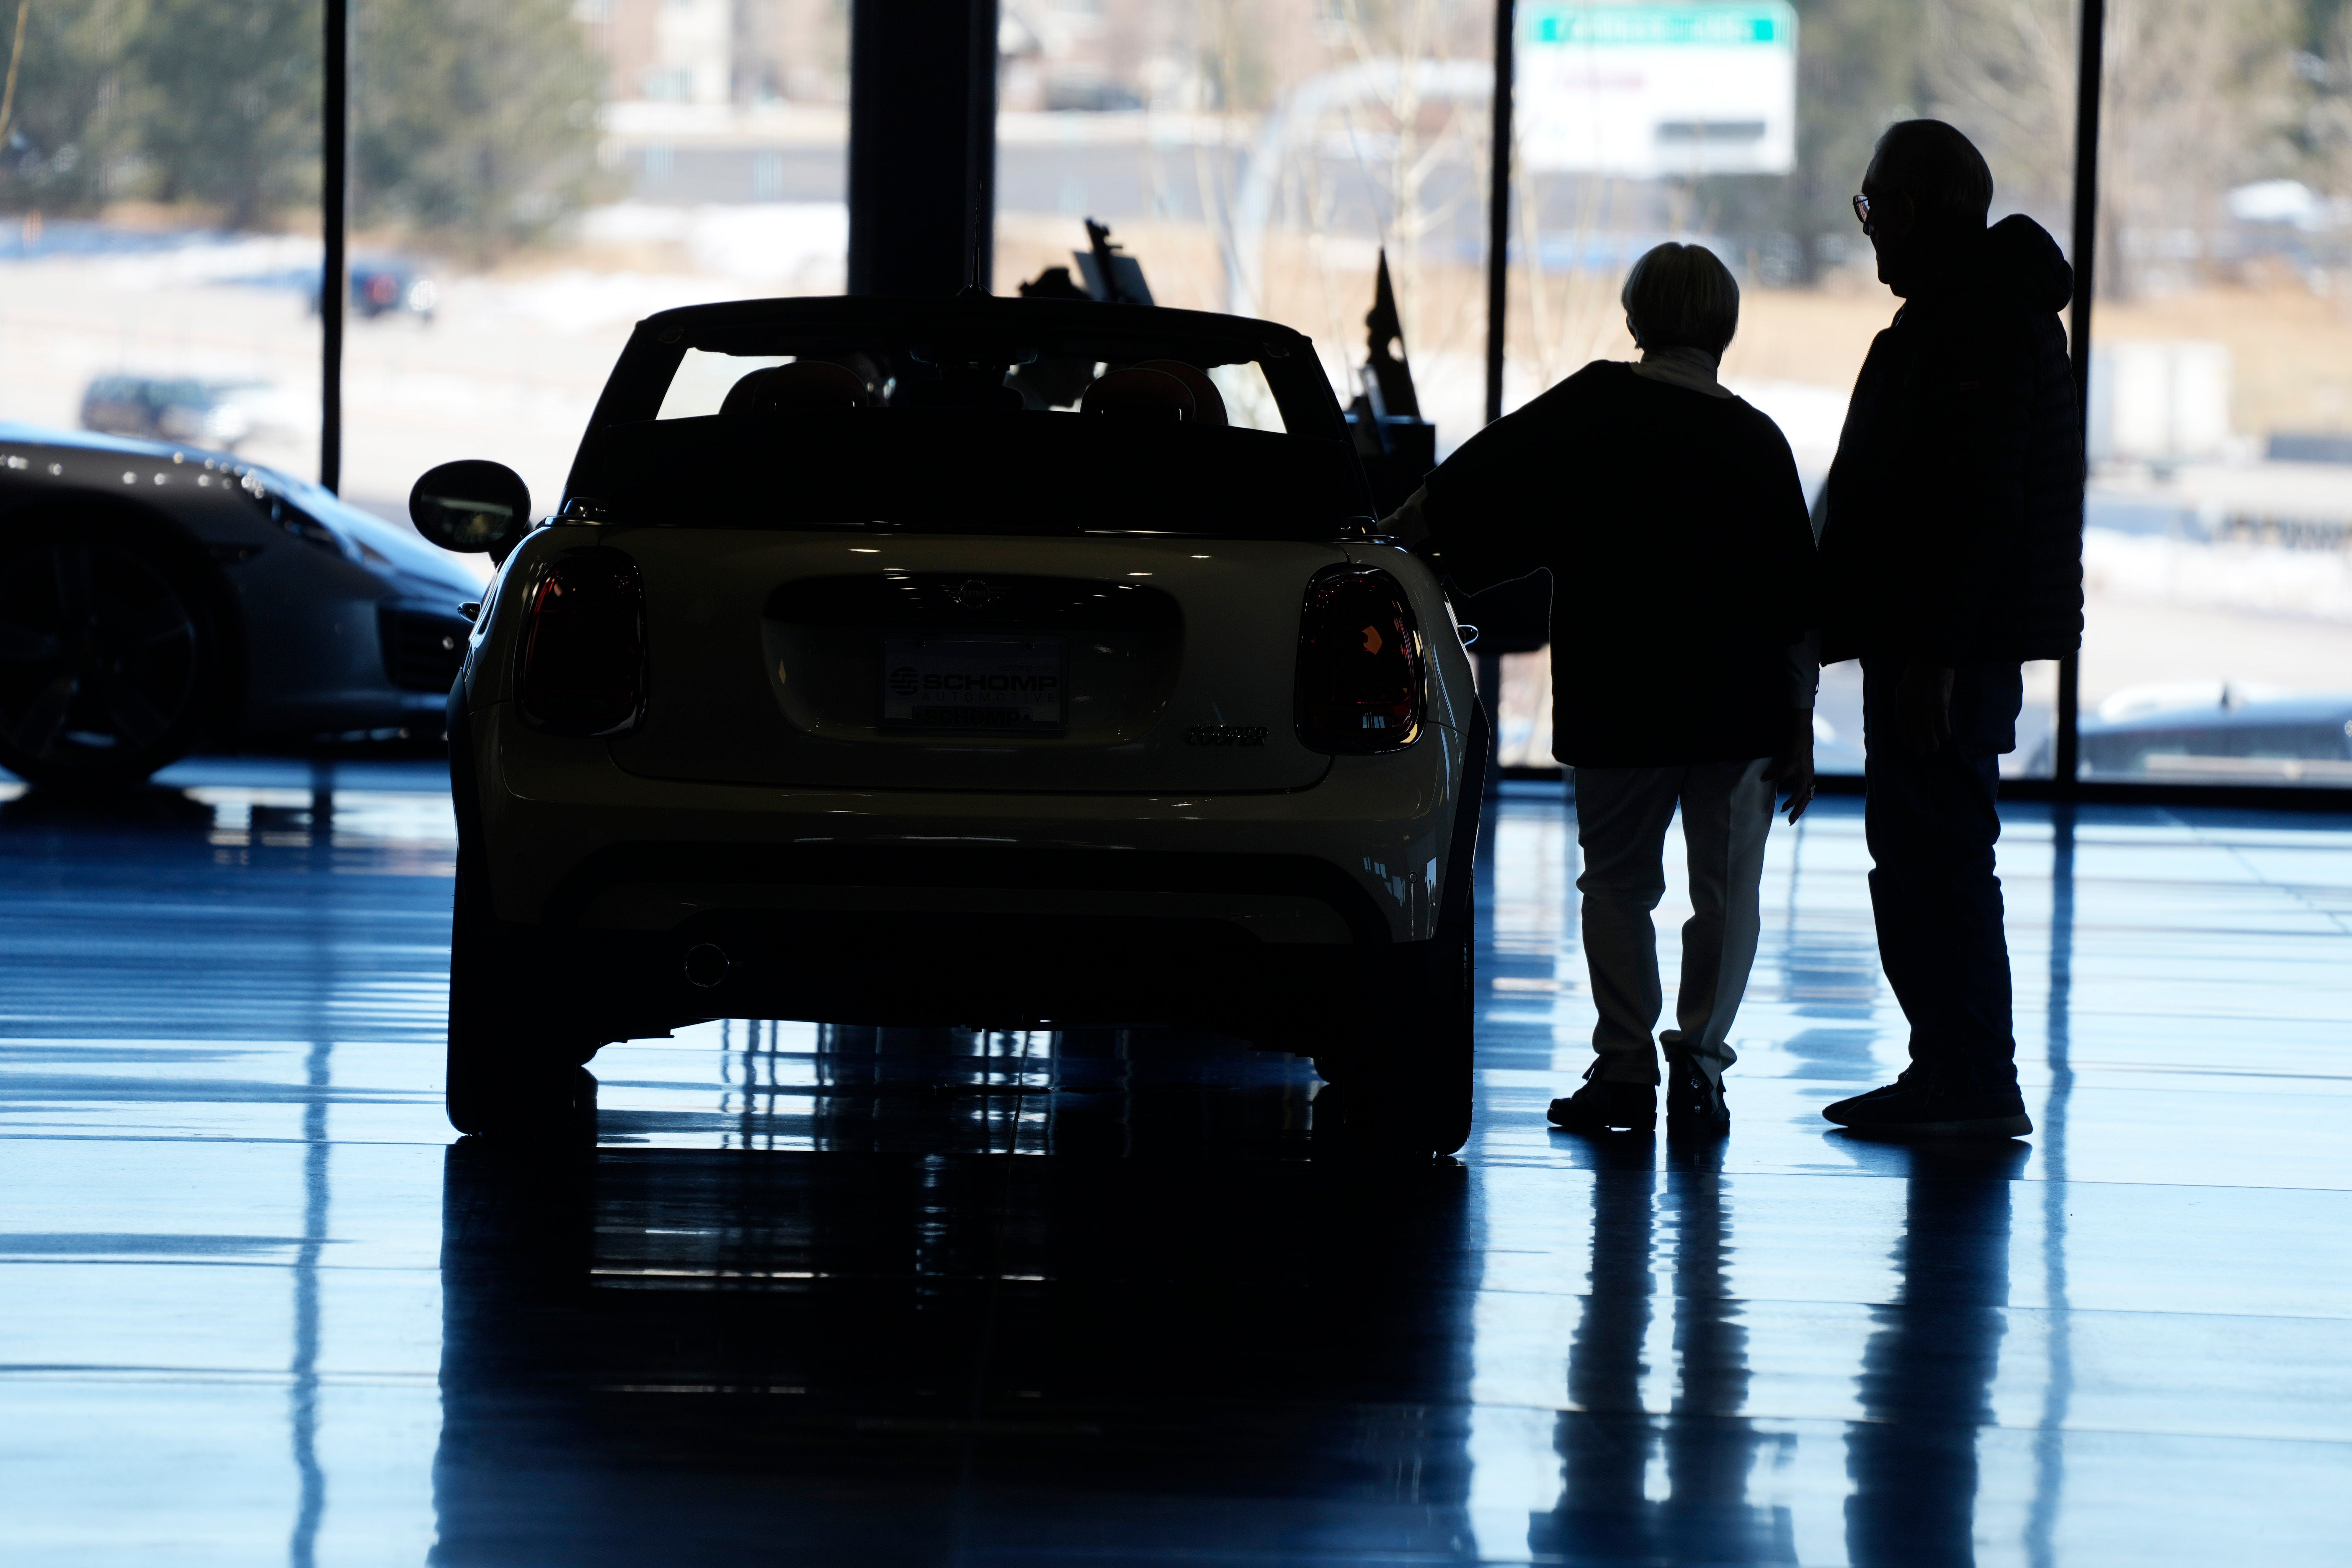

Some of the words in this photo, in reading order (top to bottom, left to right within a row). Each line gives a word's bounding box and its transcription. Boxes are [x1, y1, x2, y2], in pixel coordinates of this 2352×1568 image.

[923, 674, 1057, 691] SCHOMP
[922, 692, 1054, 702] AUTOMOTIVE
[925, 709, 1020, 725] SCHOMP
[1188, 725, 1268, 746] COOPER
